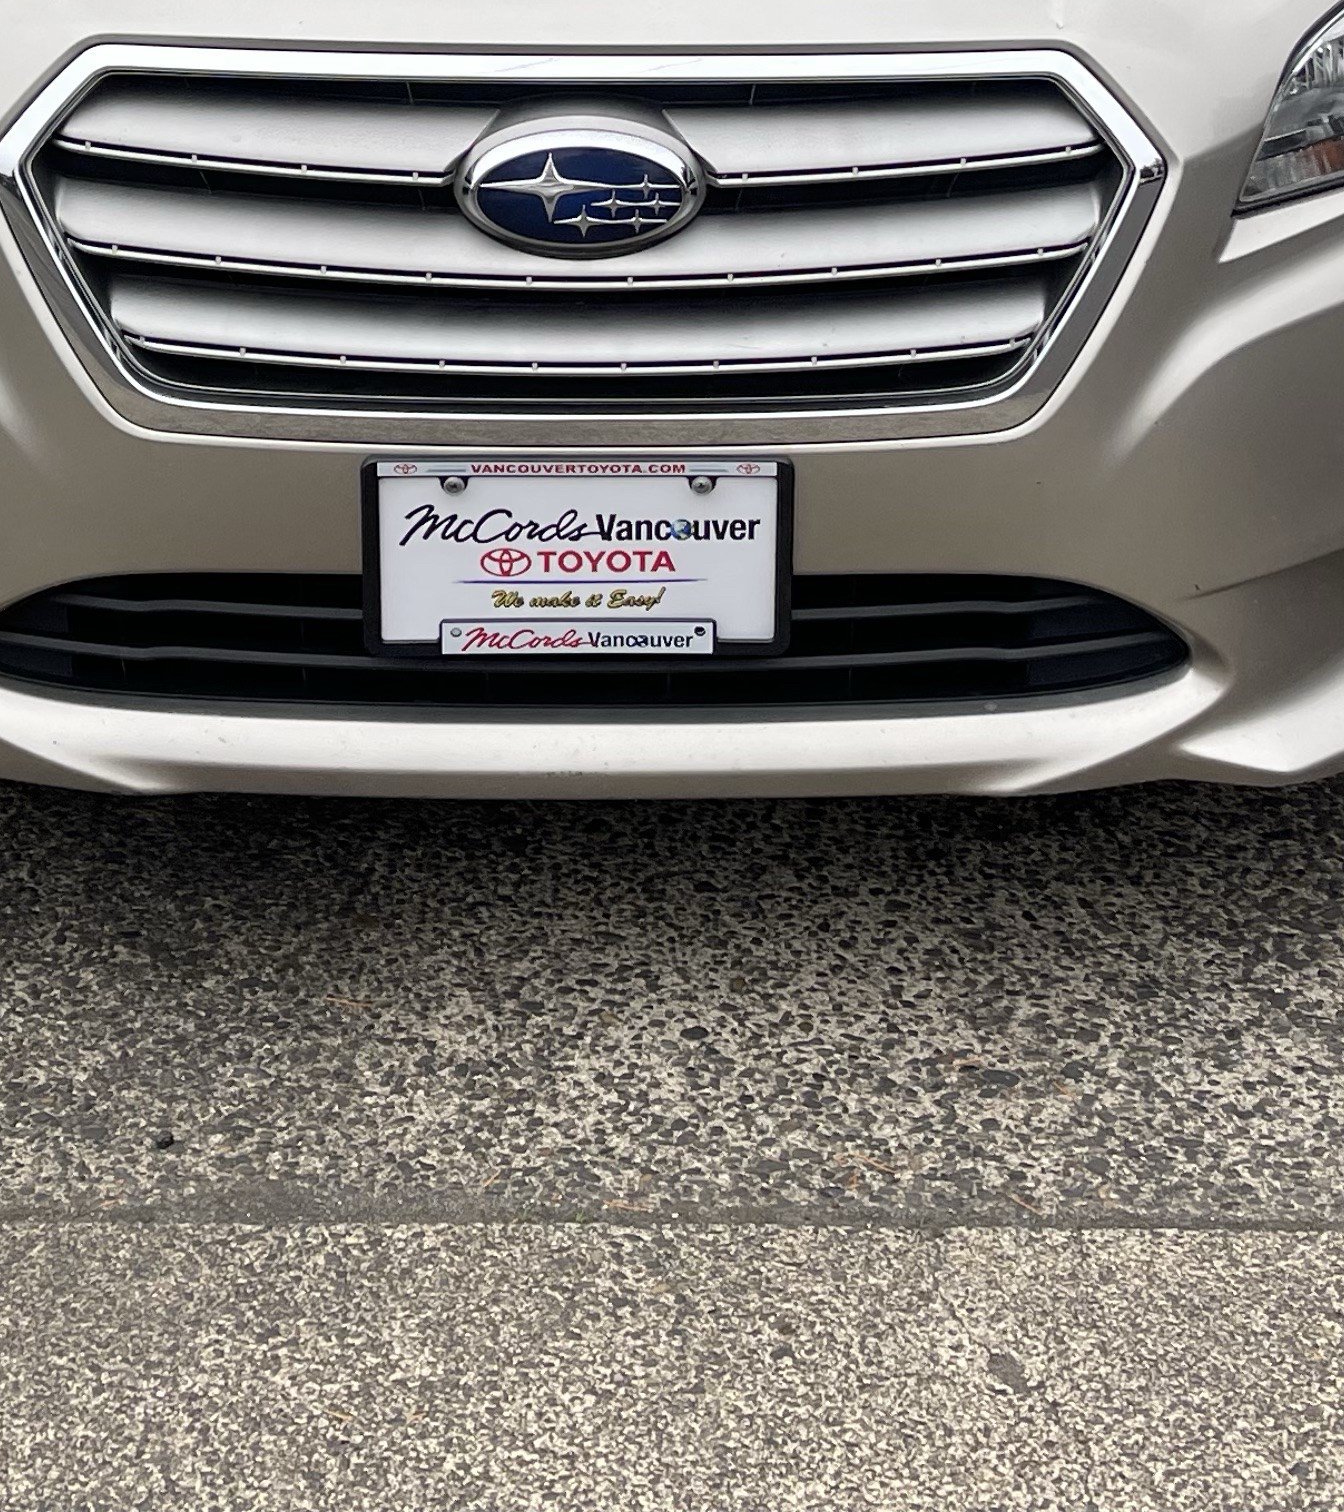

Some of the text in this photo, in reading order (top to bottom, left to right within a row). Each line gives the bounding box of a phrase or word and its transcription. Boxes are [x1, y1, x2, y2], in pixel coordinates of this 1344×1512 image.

[470, 463, 686, 475] VANCOUVERTOYOTA.COM
[399, 504, 761, 546] McCords Vancouver
[537, 550, 676, 573] TOYOTA
[491, 586, 666, 611] We make it Easy!
[461, 626, 694, 652] McCords Vancouver
